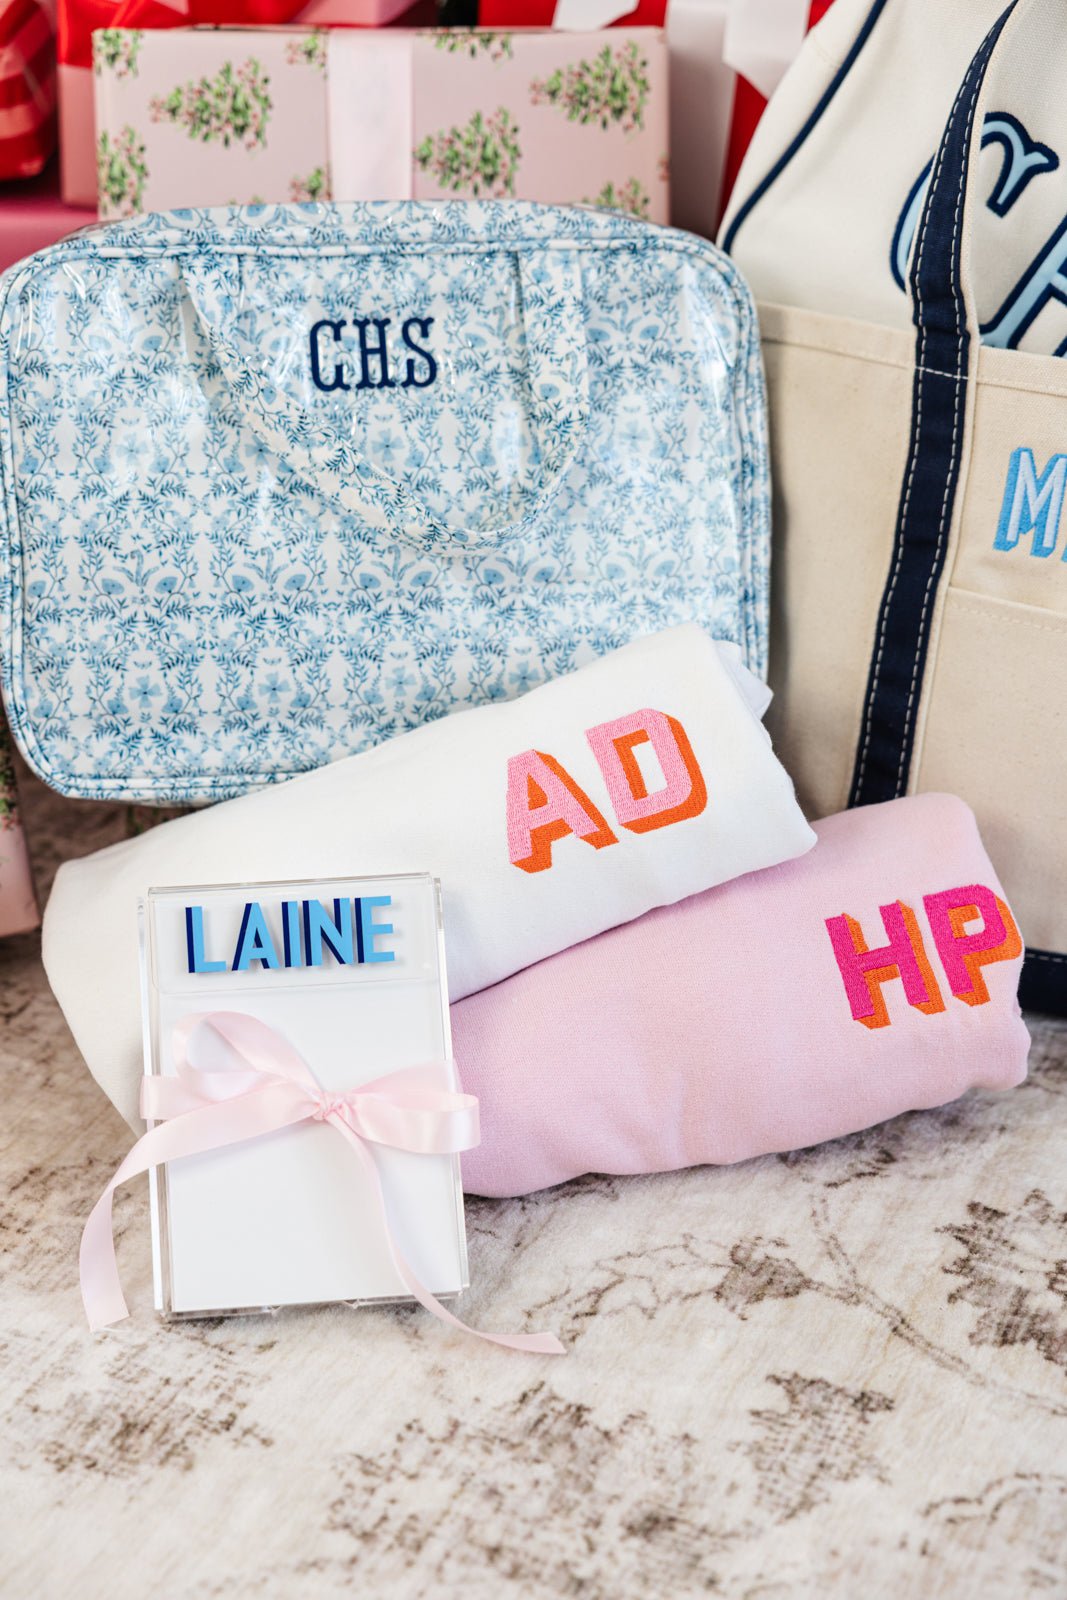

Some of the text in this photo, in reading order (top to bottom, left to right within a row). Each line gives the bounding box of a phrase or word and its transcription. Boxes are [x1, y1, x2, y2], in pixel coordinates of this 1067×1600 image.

[309, 317, 437, 392] CHS
[993, 447, 1067, 563] M
[506, 708, 708, 873] AD
[185, 896, 395, 973] LAINE
[824, 884, 1022, 1030] HP
